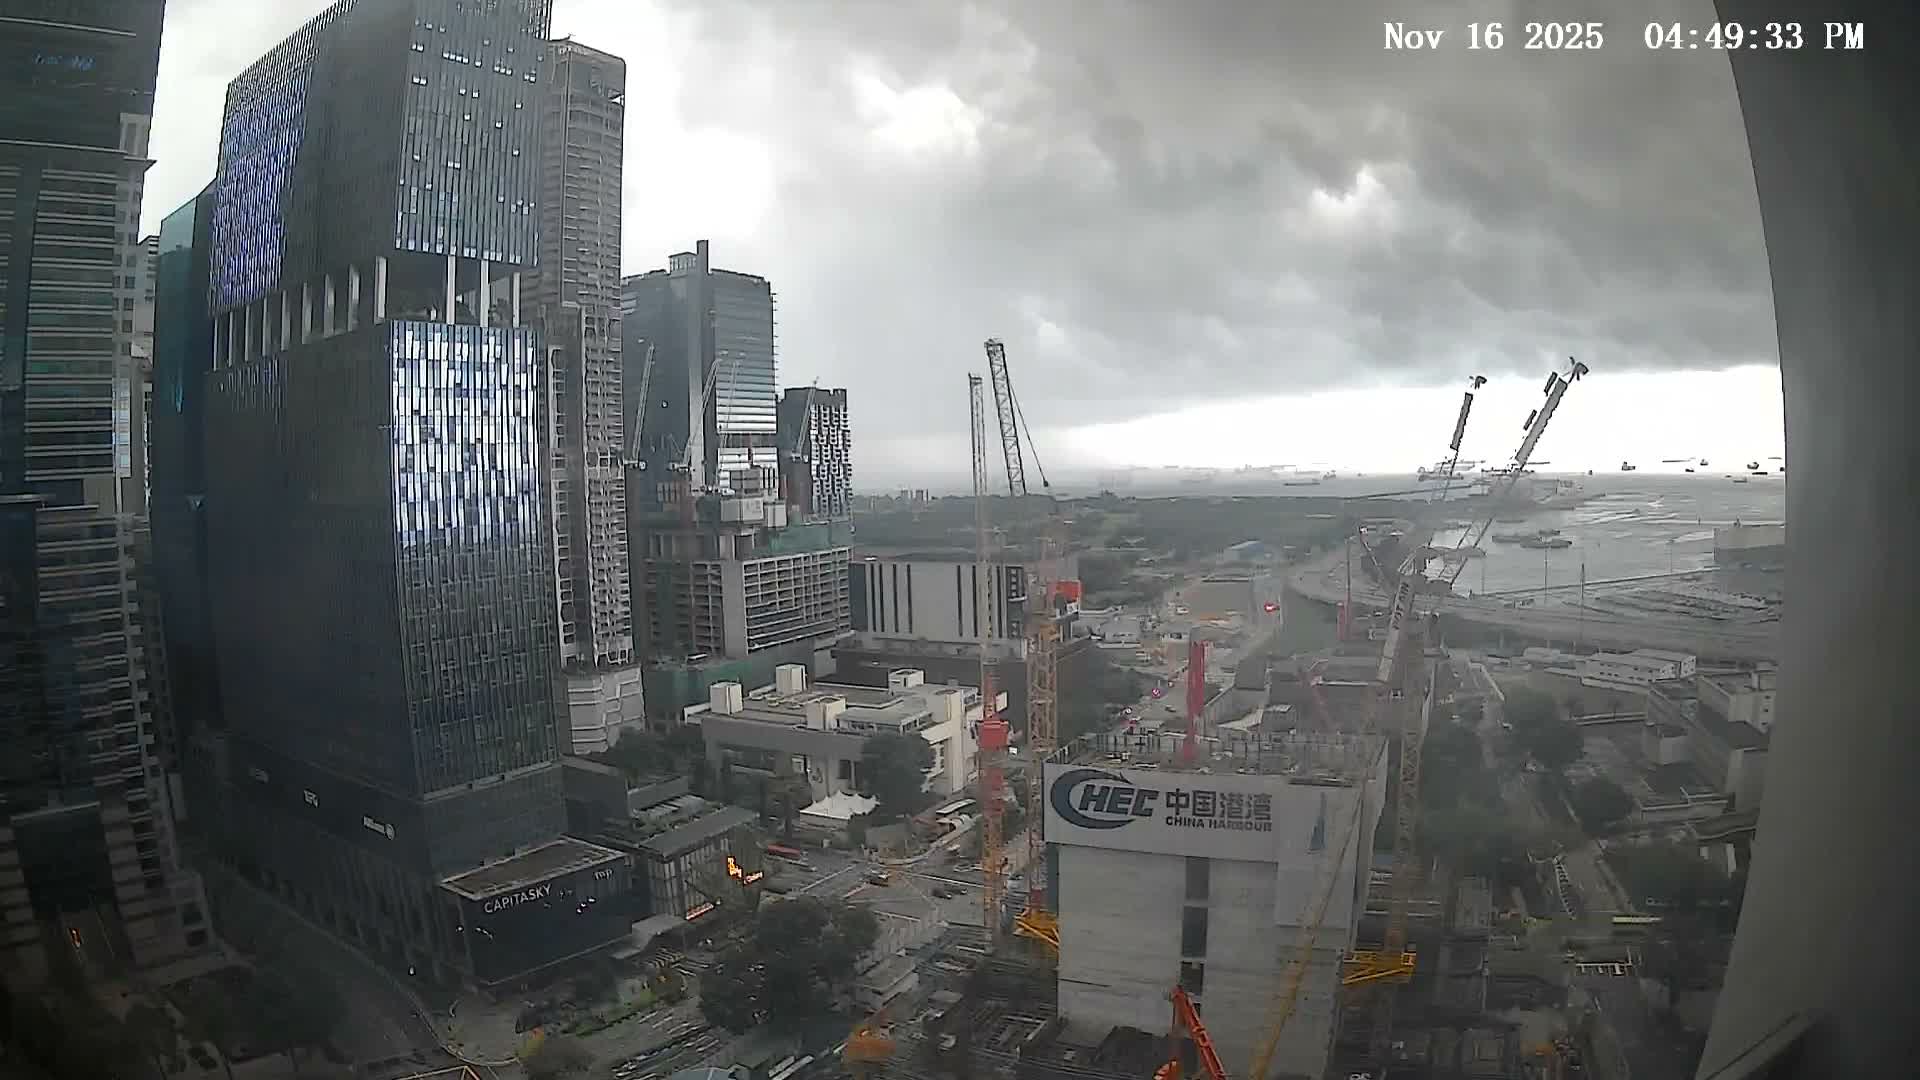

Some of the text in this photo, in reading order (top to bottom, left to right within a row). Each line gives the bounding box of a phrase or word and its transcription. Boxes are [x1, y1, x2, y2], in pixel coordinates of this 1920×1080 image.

[1166, 788, 1273, 820] 中国港湾
[1166, 816, 1205, 829] CHINA
[484, 884, 551, 913] CAPITASKY
